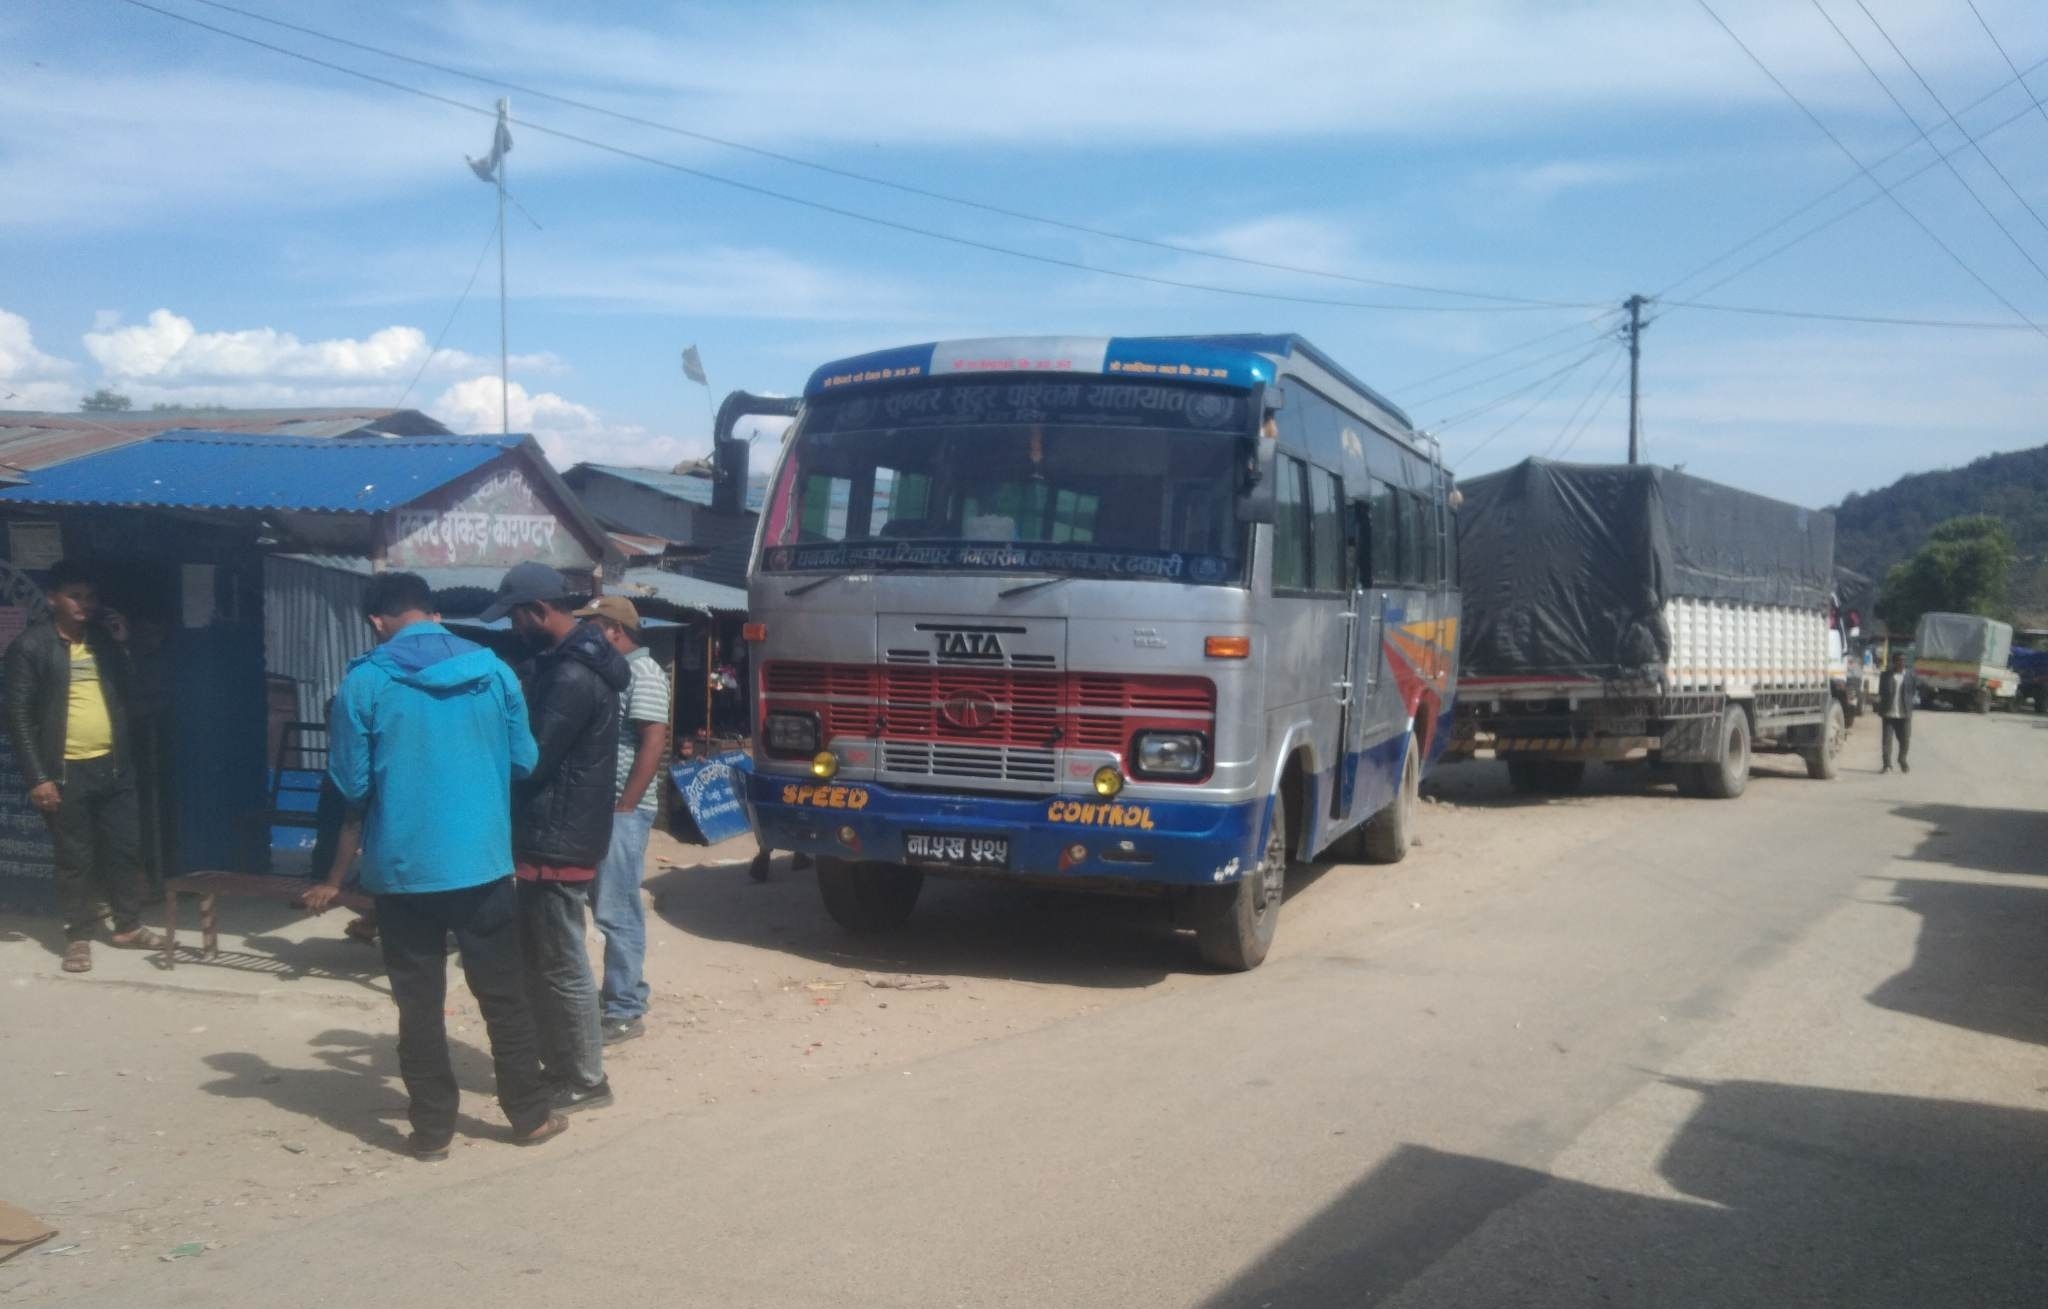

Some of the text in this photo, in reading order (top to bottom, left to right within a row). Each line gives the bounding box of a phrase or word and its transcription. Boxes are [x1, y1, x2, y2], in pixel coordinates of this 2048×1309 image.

[935, 632, 1004, 655] TATA
[782, 784, 869, 809] SPEED
[1048, 801, 1155, 829] CONTROL
